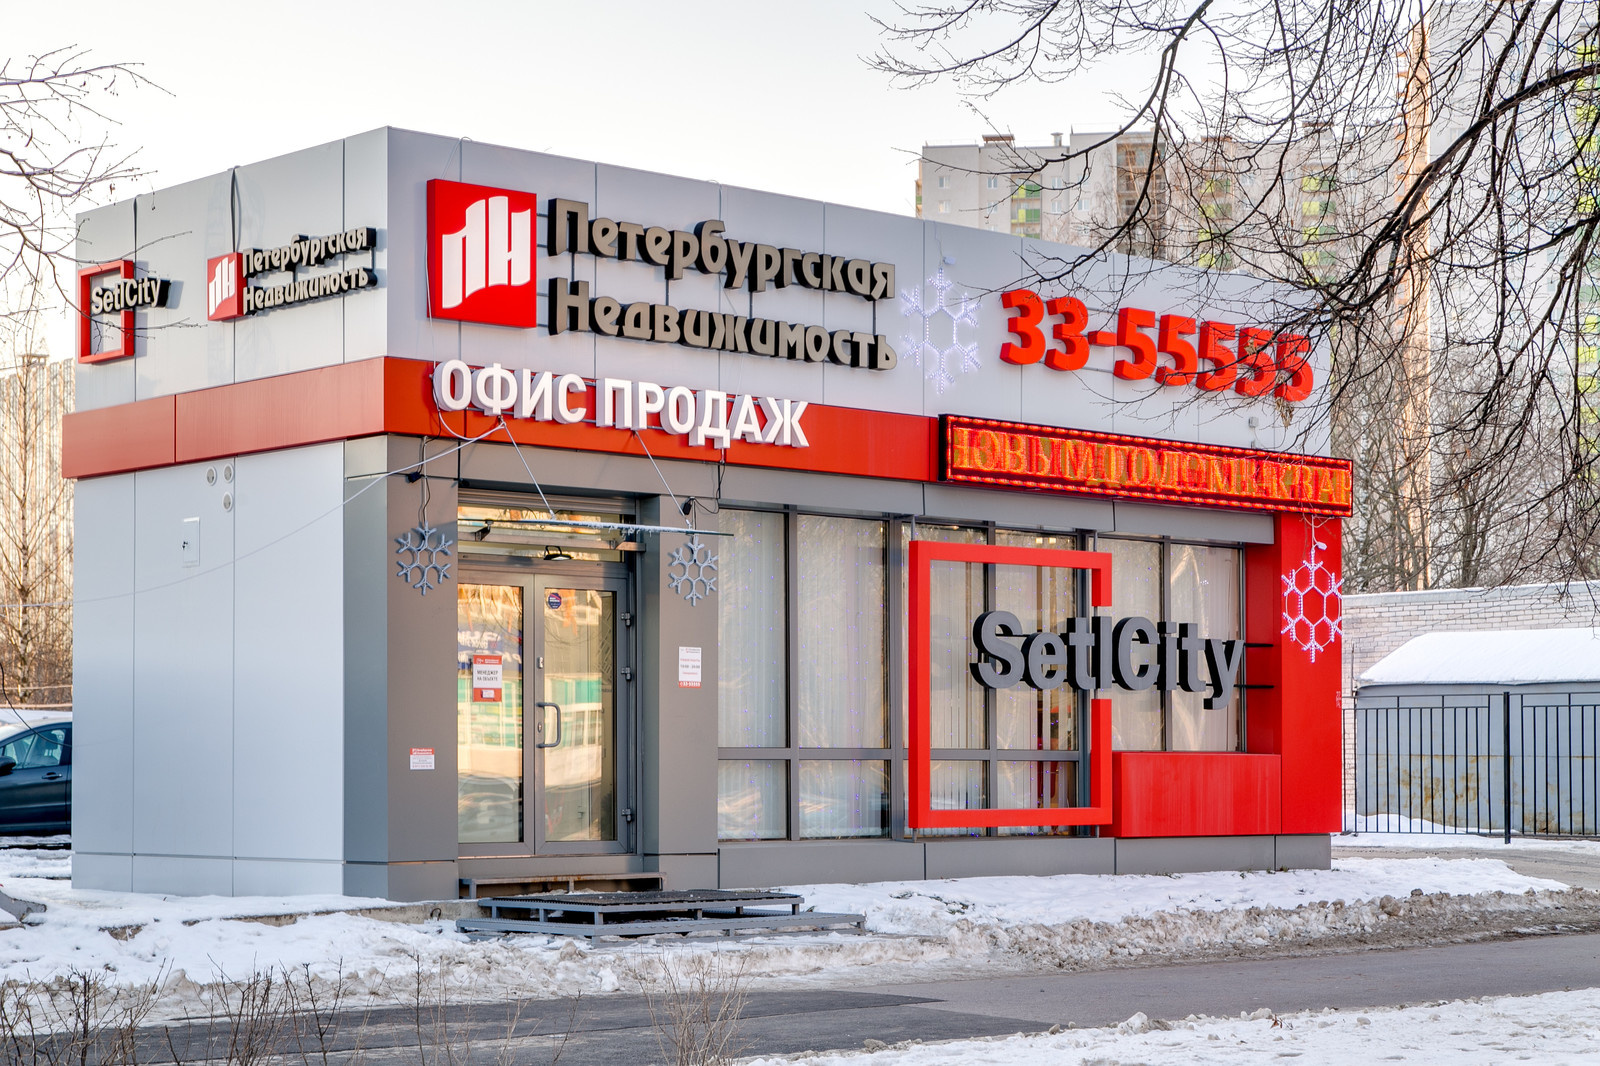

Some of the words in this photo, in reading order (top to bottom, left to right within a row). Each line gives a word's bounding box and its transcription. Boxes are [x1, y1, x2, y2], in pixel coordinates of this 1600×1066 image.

[242, 228, 376, 278] Петербургская
[243, 267, 376, 315] Недвижимость
[547, 197, 896, 301] Петербургская
[548, 277, 897, 371] Недвижимость
[999, 288, 1315, 402] 33-55555
[433, 359, 588, 425] ОФИС
[596, 377, 809, 449] ПРОДАЖ
[969, 610, 1245, 710] SetlCity
